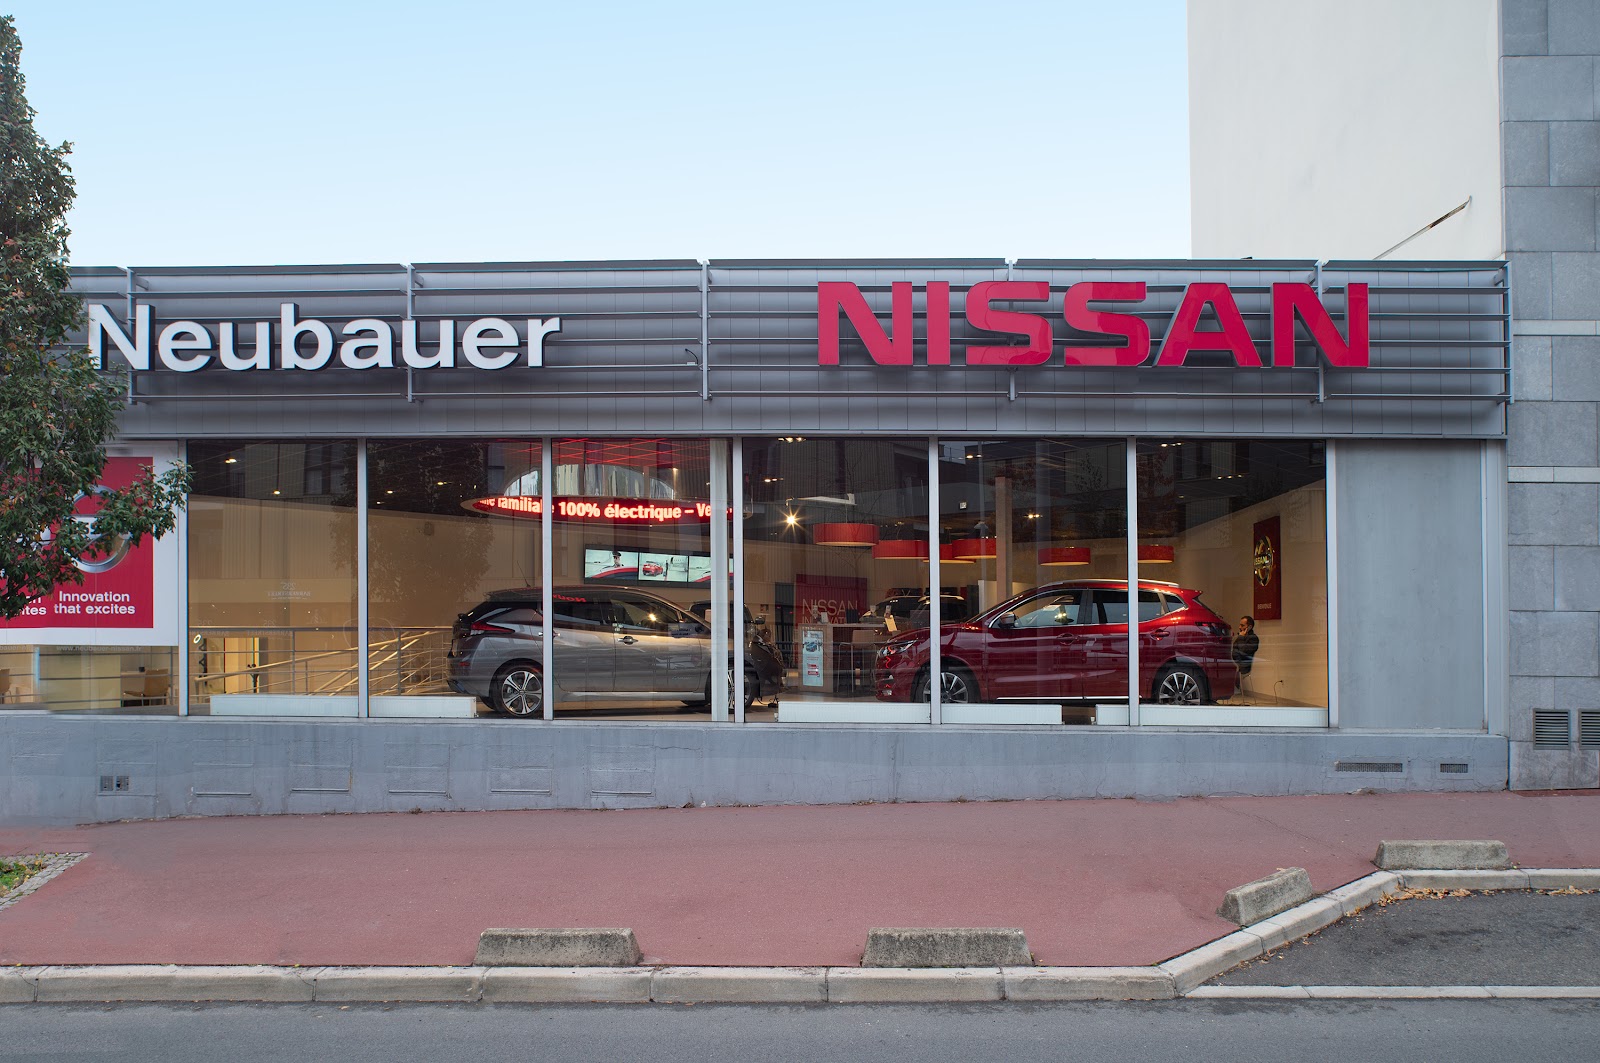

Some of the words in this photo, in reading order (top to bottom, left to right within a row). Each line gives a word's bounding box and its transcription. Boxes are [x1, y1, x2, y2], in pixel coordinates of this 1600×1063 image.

[818, 281, 1369, 367] NISSAN
[88, 302, 562, 371] Neubauer
[559, 501, 600, 518] 100%
[604, 503, 682, 522] électrique
[59, 591, 130, 602] Innovation
[54, 603, 81, 614] that
[86, 603, 136, 615] excites
